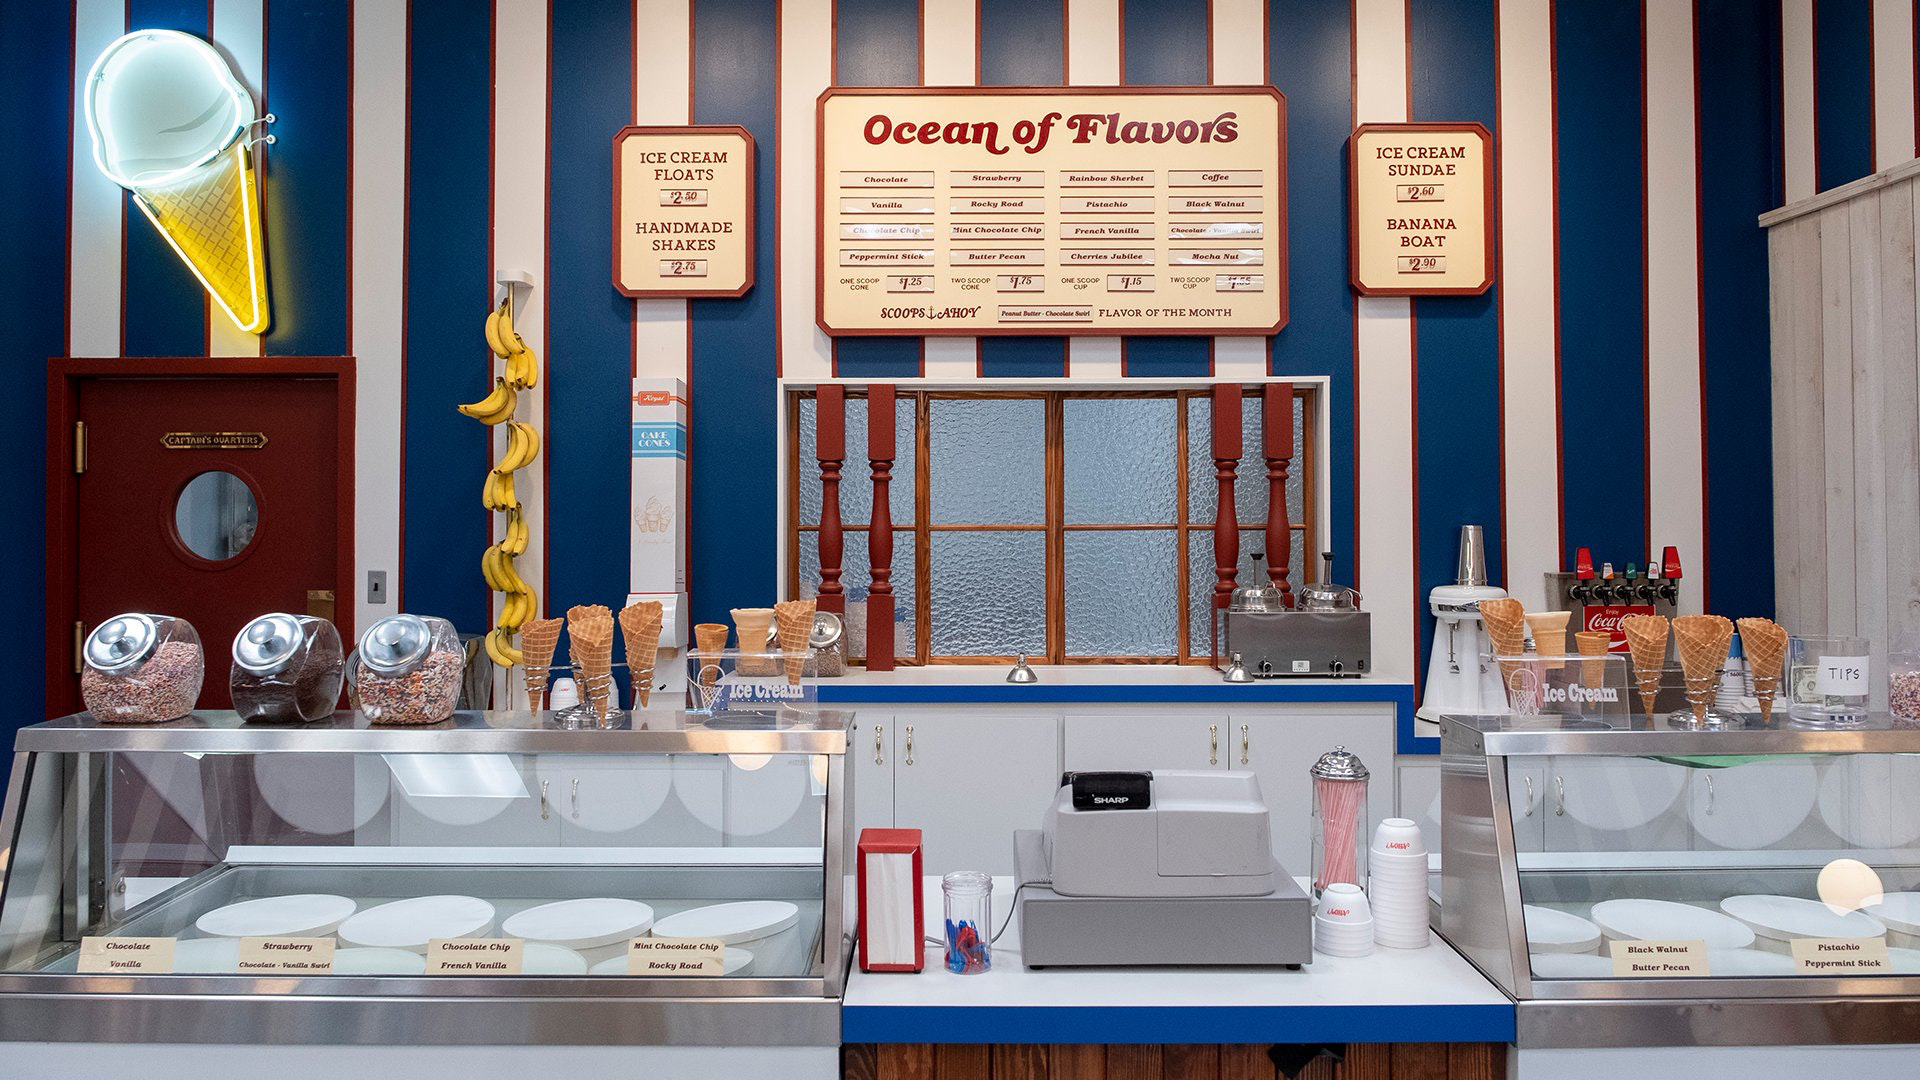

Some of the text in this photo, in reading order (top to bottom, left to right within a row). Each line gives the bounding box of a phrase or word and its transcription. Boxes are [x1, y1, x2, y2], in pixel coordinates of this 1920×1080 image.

[863, 112, 1239, 155] Ocean of Flavors
[640, 152, 728, 164] ICE CREAM
[1376, 146, 1466, 159] ICE CREAM
[654, 169, 714, 180] FLOATS
[1388, 164, 1456, 176] SUNDAE
[972, 174, 1022, 182] Strawberry
[1202, 174, 1229, 182] Coffee
[670, 191, 697, 204] $2.50
[1407, 186, 1435, 200] $2.60
[635, 222, 733, 234] HANDMADE
[1387, 219, 1457, 230] BANANA
[900, 227, 920, 235] Chip
[652, 240, 716, 251] SHAKES
[1400, 236, 1446, 247] BOAT
[849, 253, 899, 261] Peppermint
[671, 261, 696, 274] $2.75
[1409, 257, 1436, 271] $2.90
[899, 277, 922, 290] $1.25
[1010, 276, 1032, 289] $1.75
[1121, 277, 1142, 289] $1.15
[880, 305, 982, 319] SCOOPS AHOY
[1099, 308, 1232, 318] FLAVOR OF THE MONTH
[168, 436, 258, 444] CAPTAIN'S QUARTERS
[640, 431, 668, 439] CAKE
[638, 439, 671, 448] CONES
[1828, 667, 1860, 681] TIPS
[729, 684, 804, 699] Ice Cream
[1542, 683, 1618, 702] Ice Cream
[106, 942, 151, 950] Chocolate
[262, 942, 313, 952] Strawberry
[442, 943, 511, 952] Chocolate Chip
[699, 943, 719, 952] Chip
[1628, 946, 1654, 954] Black
[1818, 943, 1860, 951] Pistachio
[110, 960, 142, 968] Vanilla
[238, 961, 276, 969] Chocolate
[282, 961, 309, 969] Vanilla
[440, 962, 473, 970] French
[648, 962, 703, 971] Rocky Road
[1805, 960, 1856, 968] Peppermint
